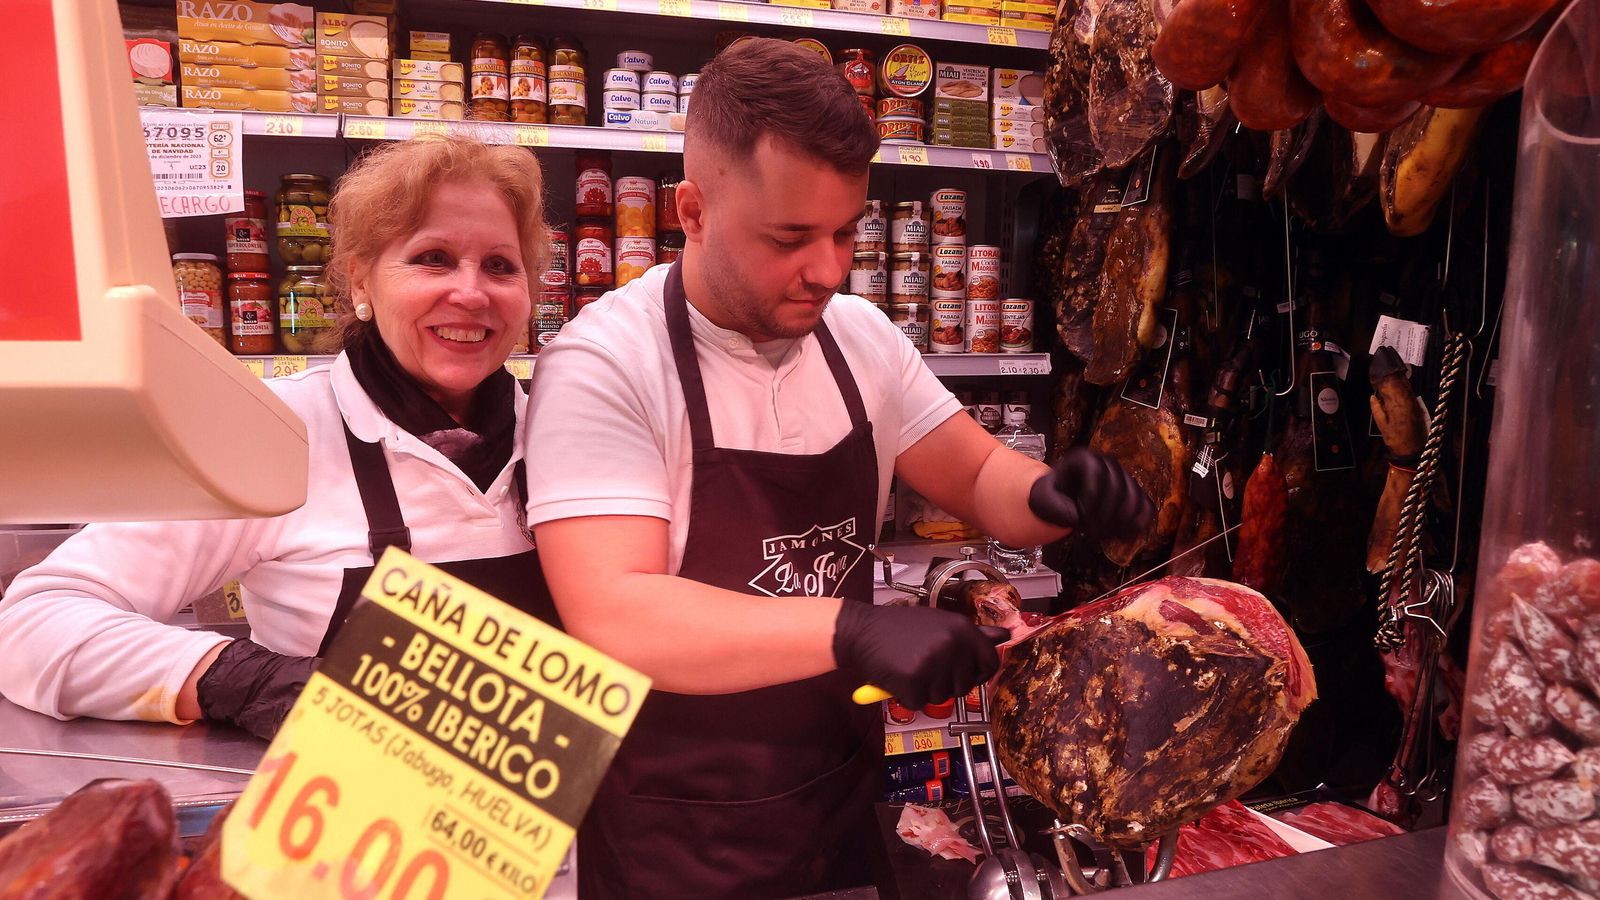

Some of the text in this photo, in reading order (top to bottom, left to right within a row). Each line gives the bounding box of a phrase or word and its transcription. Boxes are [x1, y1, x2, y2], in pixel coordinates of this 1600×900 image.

[181, 1, 253, 22] RAZO
[321, 18, 348, 27] ALBO
[182, 43, 219, 55] RAZO
[320, 39, 348, 47] BONITO
[184, 67, 220, 78] RAZO
[940, 70, 960, 79] MIAU
[185, 89, 222, 100] RAZO
[608, 113, 630, 121] Calvo
[266, 122, 294, 134] 2.10
[160, 195, 231, 215] ECARGO
[902, 327, 921, 335] MIAU
[273, 366, 299, 378] 2.95
[769, 523, 852, 554] JAMONES
[381, 567, 631, 717] CAÑA DE LOMO
[399, 632, 545, 744] BELLOTA
[351, 654, 561, 799] 100% IBERICO
[311, 686, 552, 852] 5 JOTAS (Jabugo, HUELVA)
[248, 751, 450, 900] 16.00
[431, 811, 487, 858] 64,00
[499, 861, 536, 894] KILO
